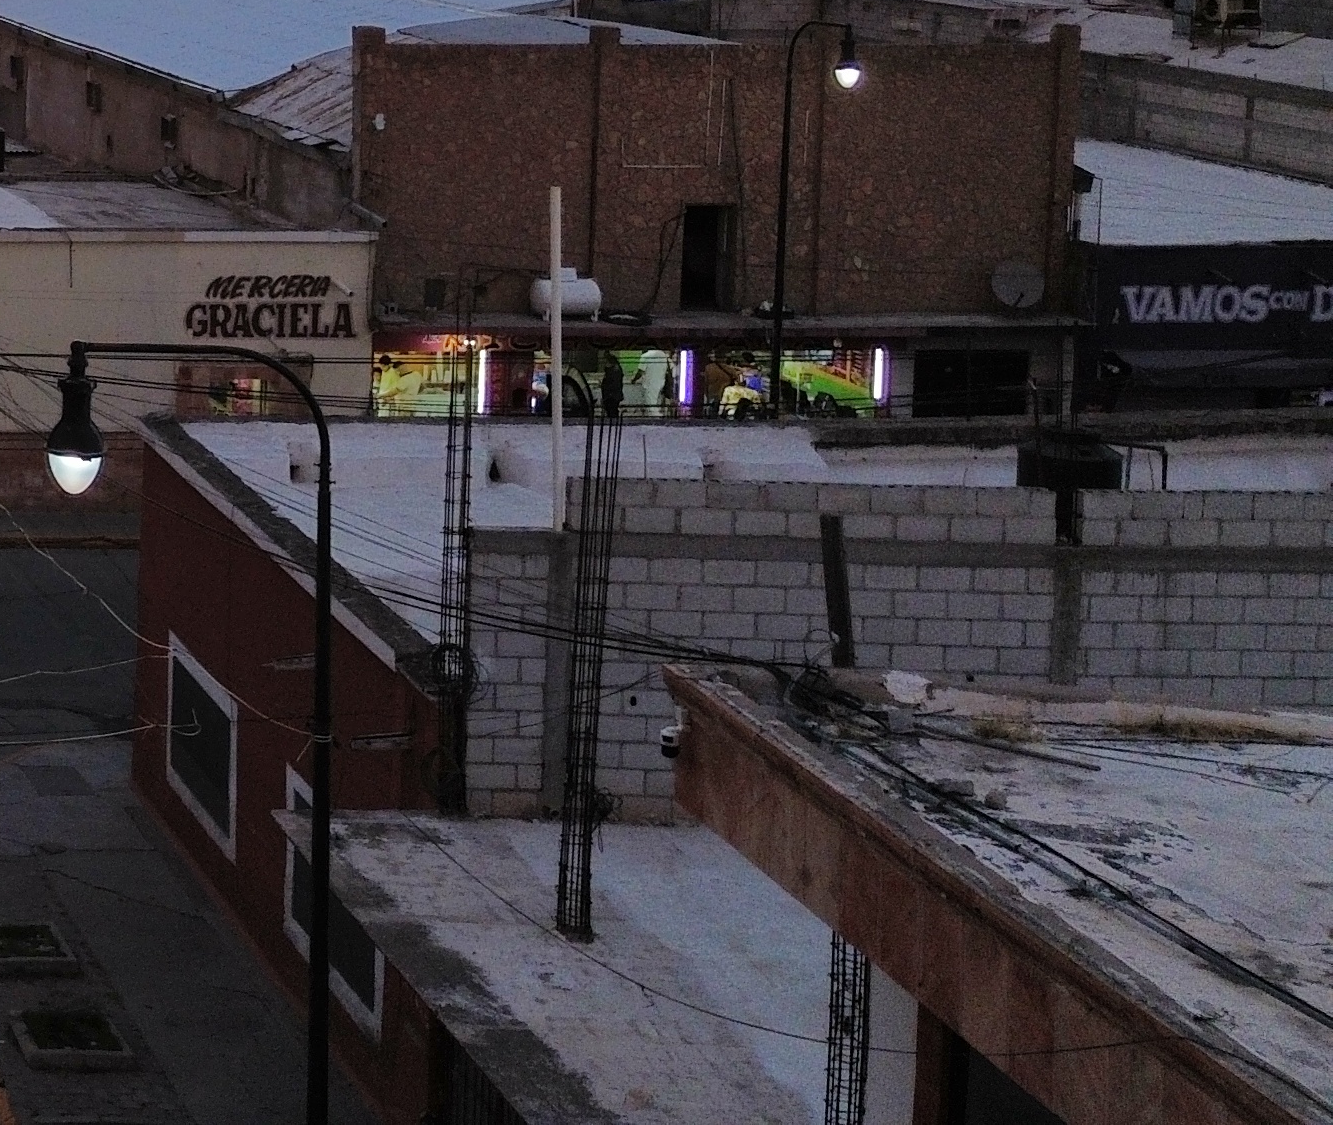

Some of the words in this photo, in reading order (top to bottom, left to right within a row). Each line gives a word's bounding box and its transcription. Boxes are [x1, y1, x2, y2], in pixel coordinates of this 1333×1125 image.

[205, 275, 331, 299] MERCERIA
[1119, 283, 1271, 324] VAMOS
[185, 303, 356, 338] GRACIELA
